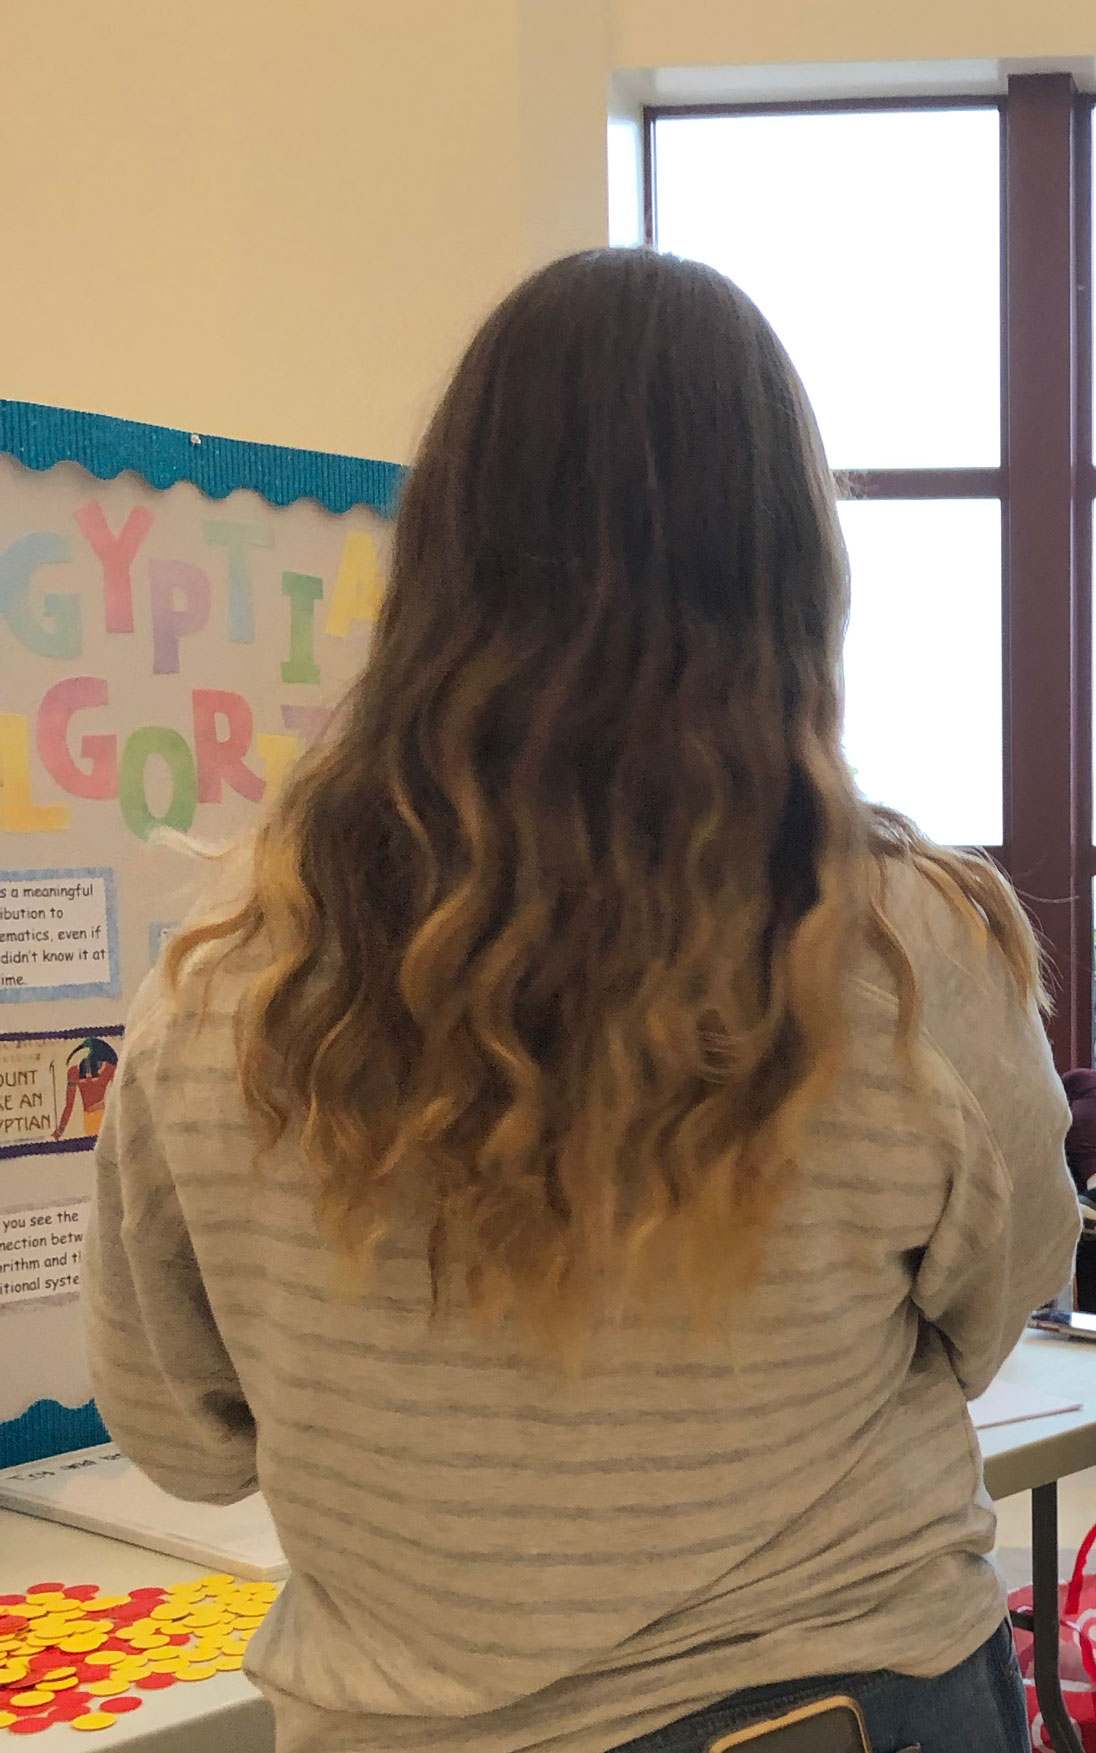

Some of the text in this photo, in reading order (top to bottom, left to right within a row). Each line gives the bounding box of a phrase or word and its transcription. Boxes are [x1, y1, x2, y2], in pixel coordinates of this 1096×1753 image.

[11, 887, 19, 898] a
[23, 884, 94, 900] meaningful
[50, 907, 64, 919] to
[57, 930, 87, 940] even
[91, 926, 102, 940] if
[1, 949, 105, 964] didn't know it at
[20, 1093, 42, 1109] AN
[3, 1210, 79, 1233] you see the
[44, 1252, 67, 1268] and
